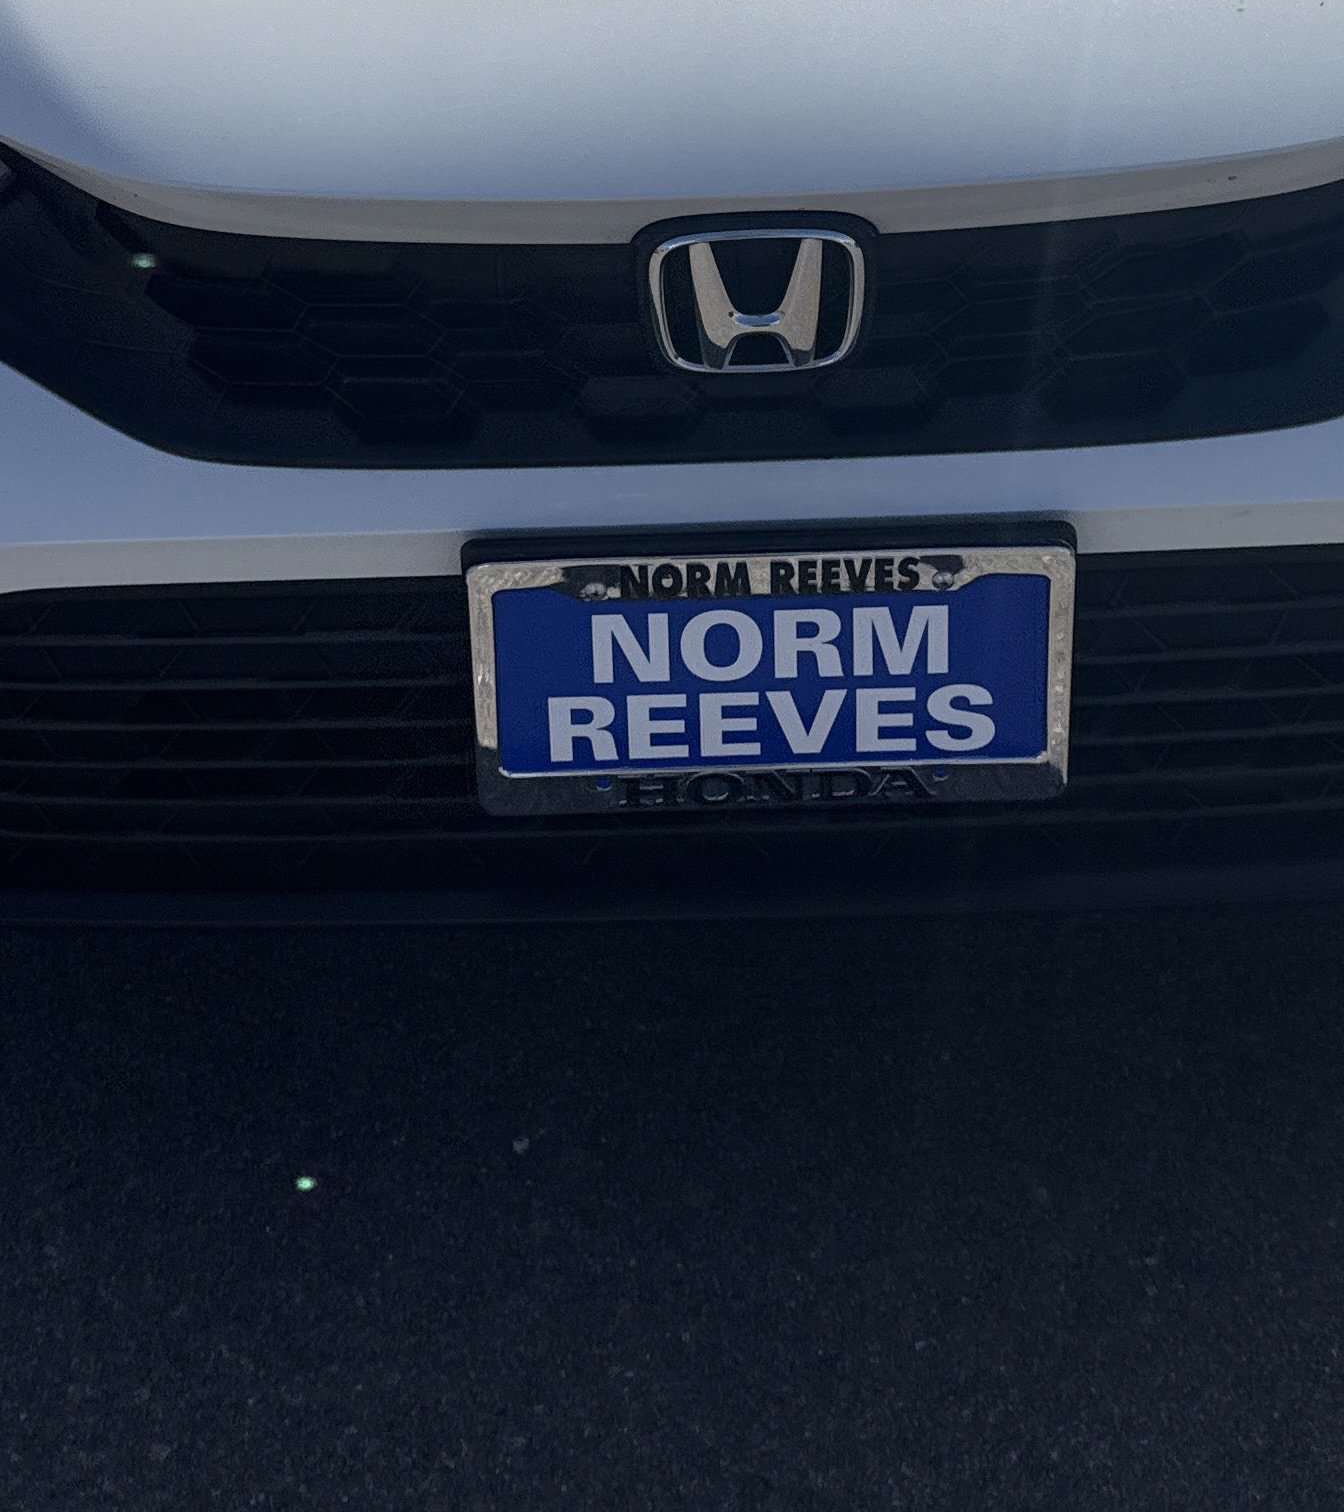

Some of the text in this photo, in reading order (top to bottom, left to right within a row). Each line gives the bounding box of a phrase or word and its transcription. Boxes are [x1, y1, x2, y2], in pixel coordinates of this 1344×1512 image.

[619, 556, 921, 598] NORM REEVES
[591, 604, 950, 684] NORM
[547, 684, 996, 763] REEVES
[614, 765, 938, 808] HONDA
